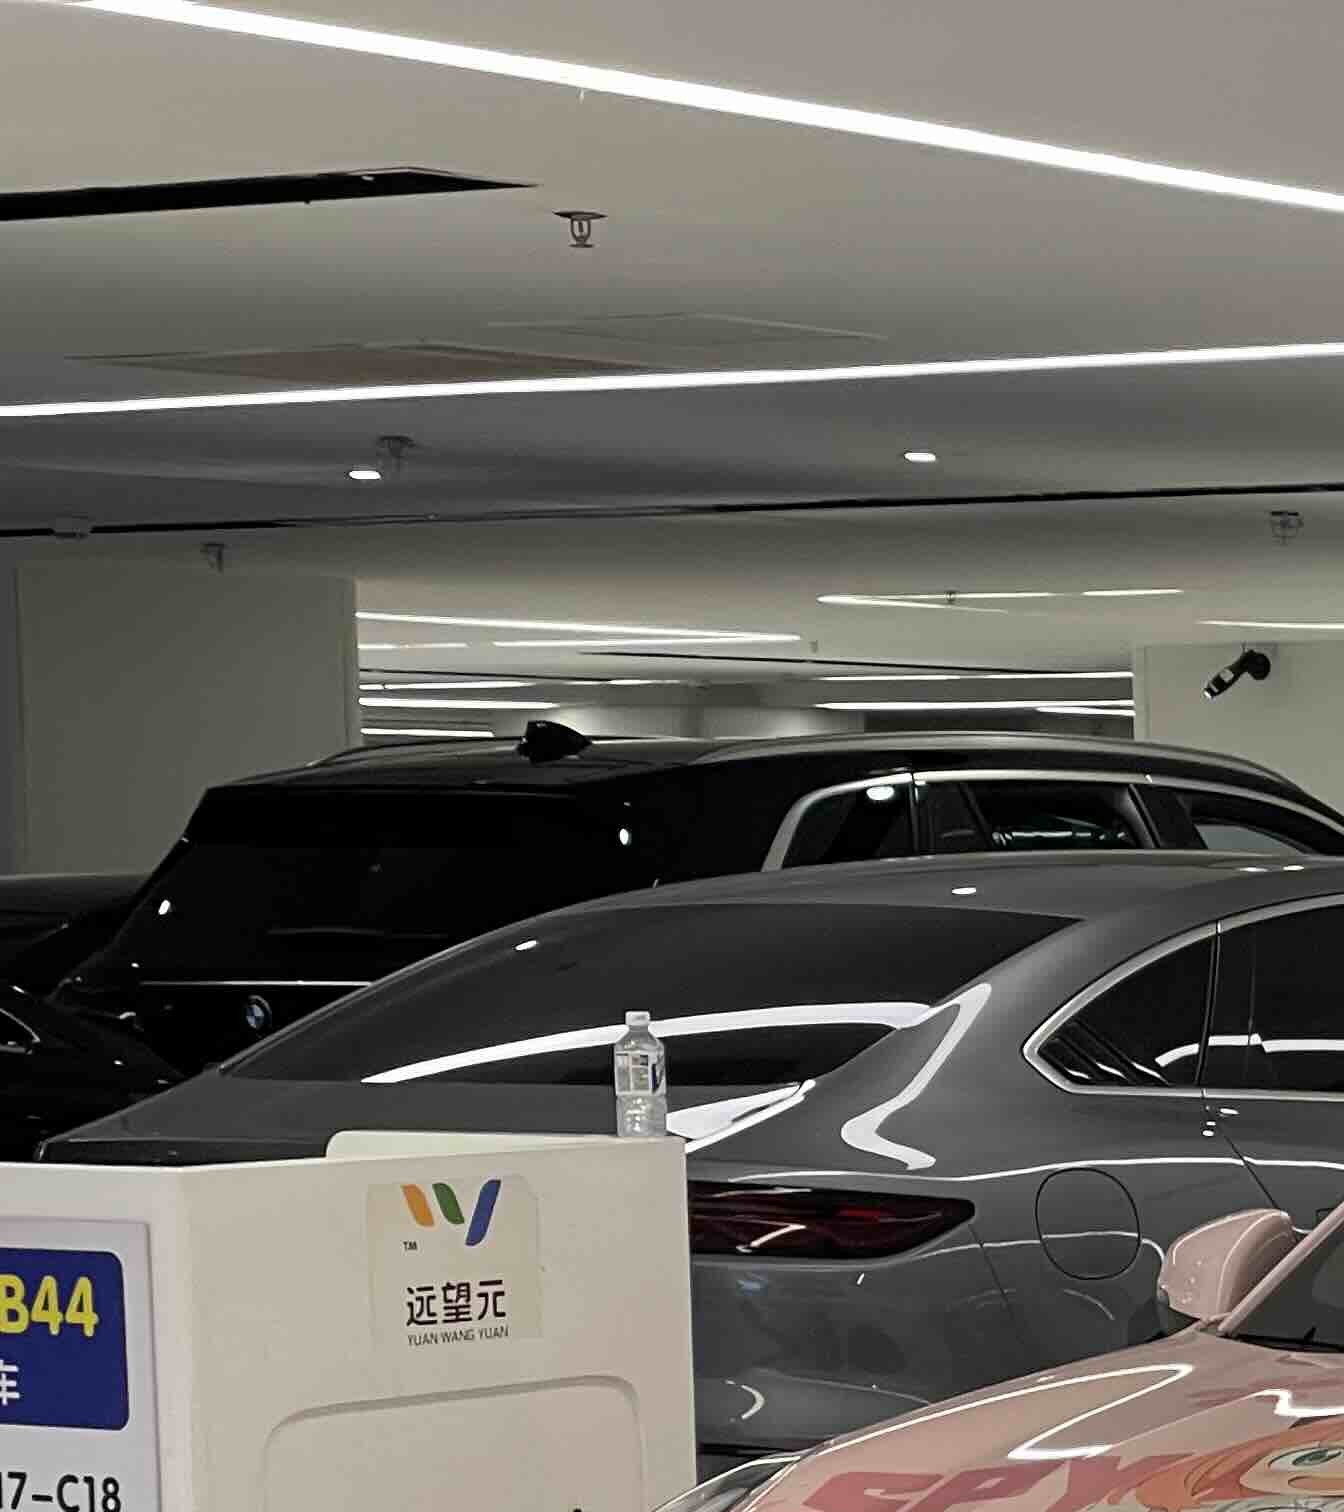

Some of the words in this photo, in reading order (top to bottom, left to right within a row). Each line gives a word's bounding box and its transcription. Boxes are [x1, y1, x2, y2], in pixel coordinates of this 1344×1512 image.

[403, 1241, 418, 1251] TM
[406, 1279, 506, 1327] 远望元
[407, 1334, 438, 1346] YUAN
[441, 1329, 475, 1345] WANG
[478, 1326, 509, 1340] YUAN
